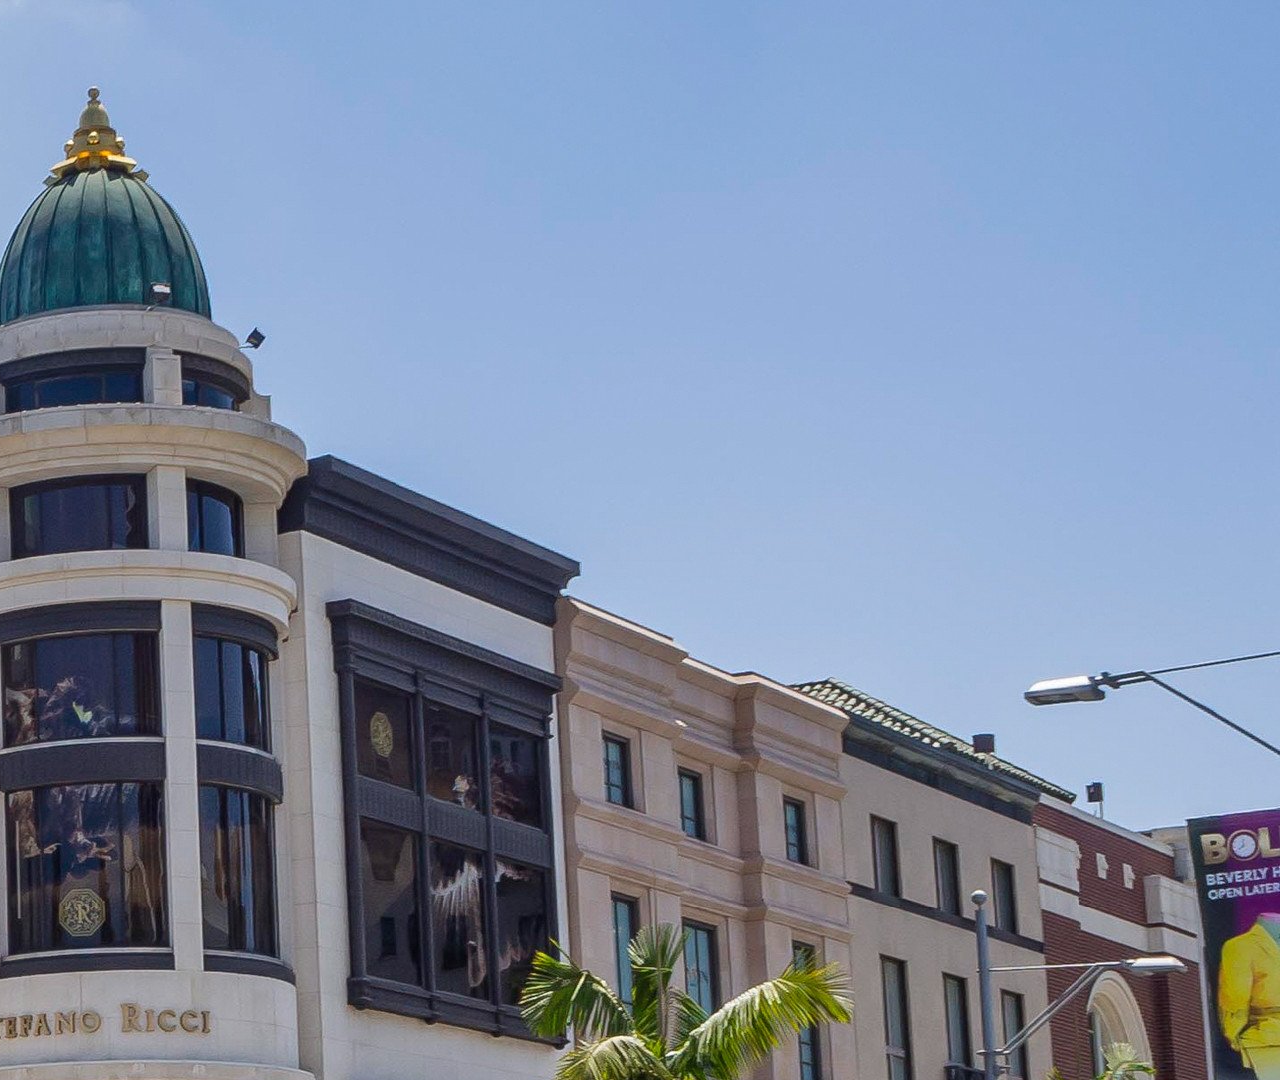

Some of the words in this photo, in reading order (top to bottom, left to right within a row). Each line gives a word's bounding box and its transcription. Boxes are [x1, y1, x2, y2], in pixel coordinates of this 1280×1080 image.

[1205, 867, 1269, 886] BEVERLY
[1208, 886, 1243, 900] OPEN
[120, 1002, 211, 1034] RICCI
